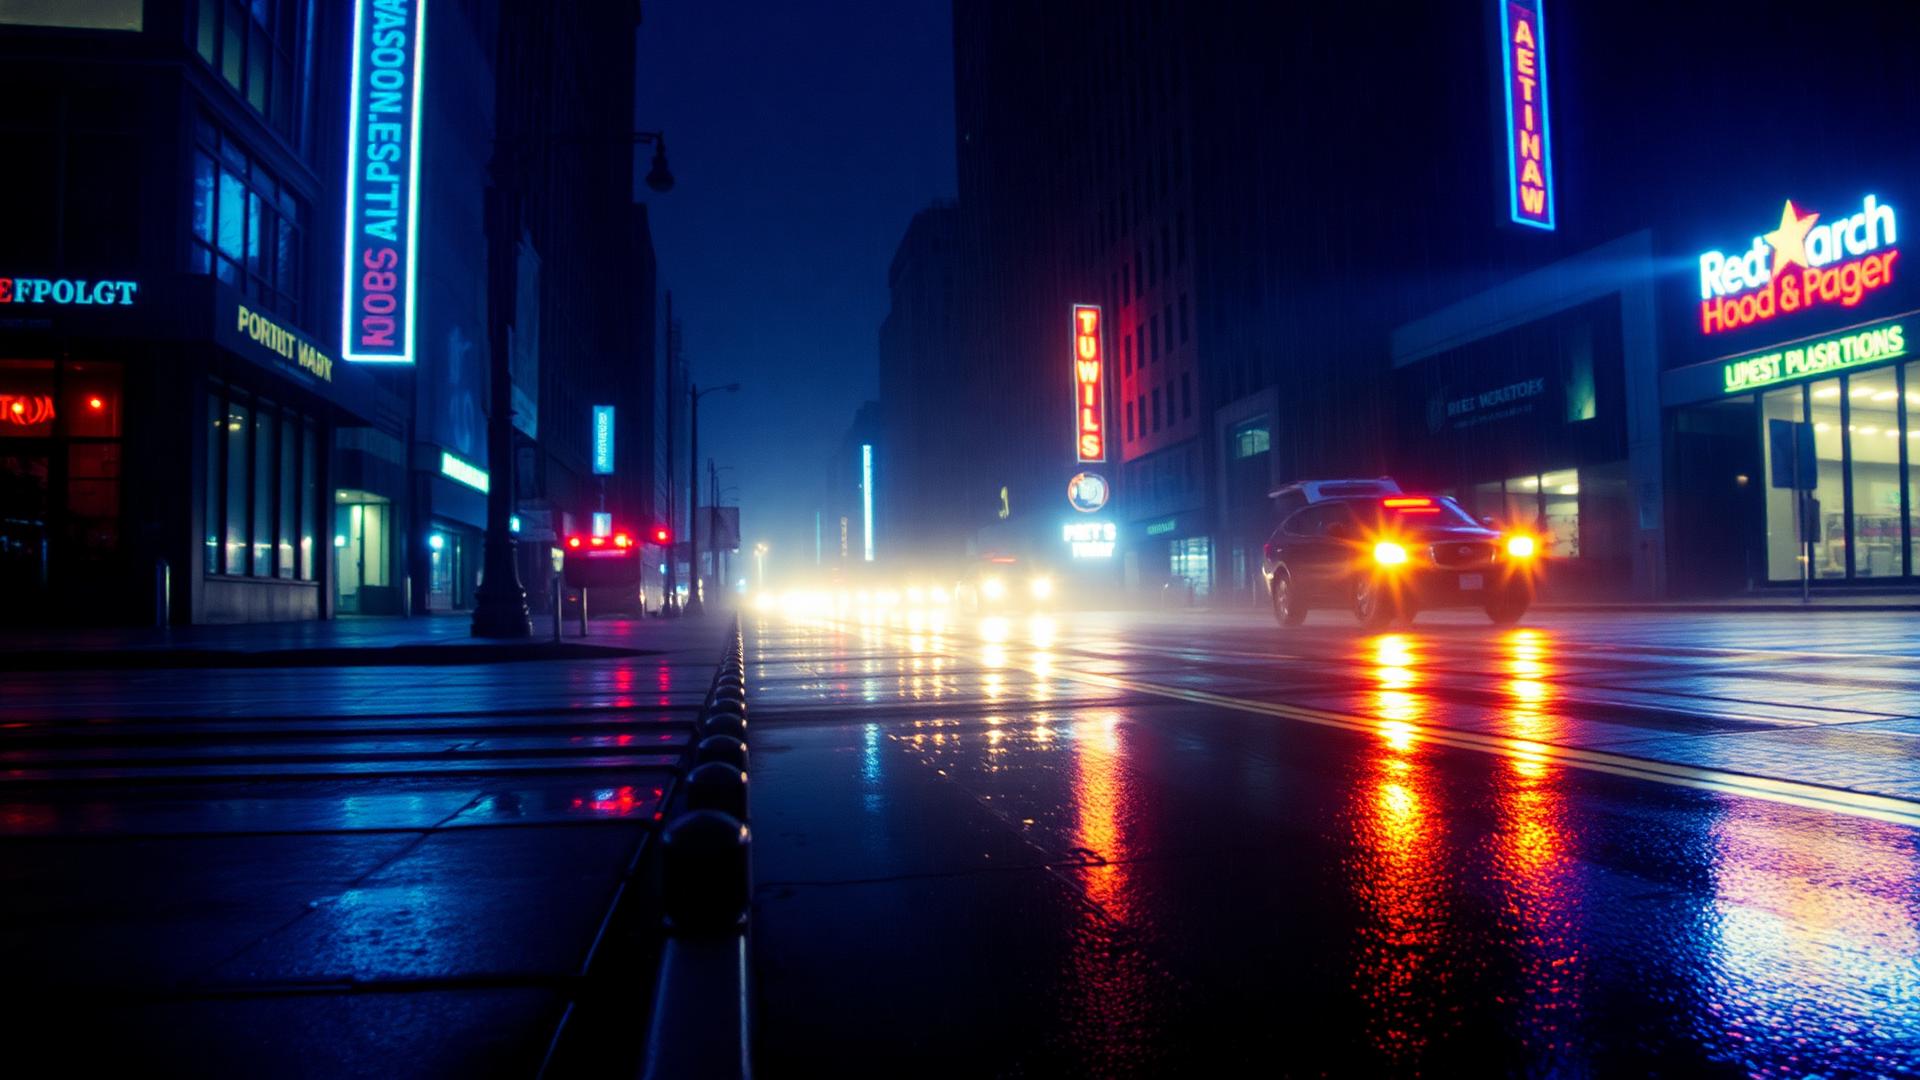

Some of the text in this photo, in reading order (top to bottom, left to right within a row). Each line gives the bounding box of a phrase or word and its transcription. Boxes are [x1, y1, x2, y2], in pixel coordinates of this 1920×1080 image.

[1514, 20, 1545, 214] AETINAW
[1804, 194, 1897, 266] arch
[1701, 249, 1899, 335] Hood & Pager
[1077, 311, 1100, 457] TUWILS
